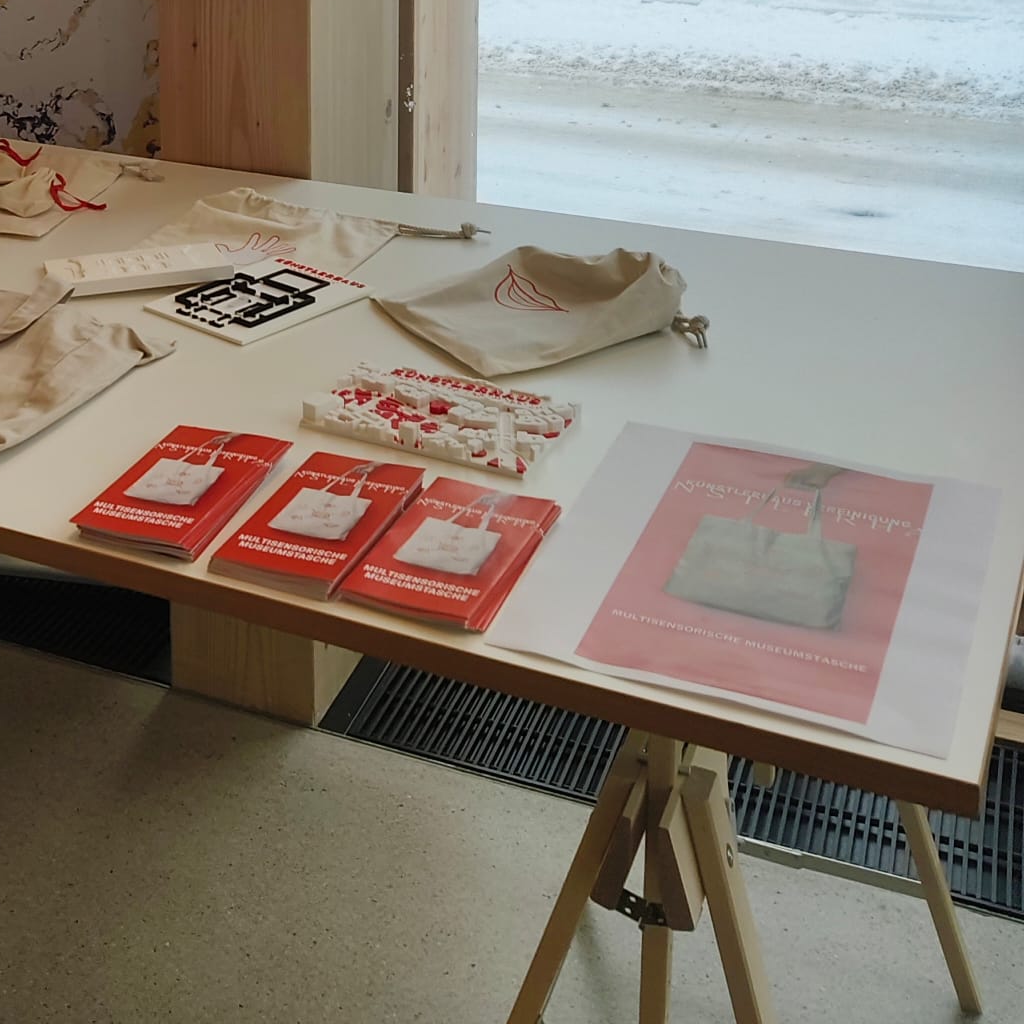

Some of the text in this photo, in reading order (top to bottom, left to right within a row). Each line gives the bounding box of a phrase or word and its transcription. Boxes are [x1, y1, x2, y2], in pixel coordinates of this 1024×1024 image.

[92, 507, 184, 529] MUSEUMSTASCHE
[93, 500, 195, 525] MULTISENSORISCHE
[238, 533, 348, 562] MULTISENSORISCHE
[238, 541, 337, 566] MUSEUMSTASCHE
[363, 563, 480, 597] MULTISENSORISCHE
[364, 571, 470, 602] MUSEUMSTASCHE
[611, 607, 868, 673] MULTISENSORISCHE MUSEUMSTASCHE
